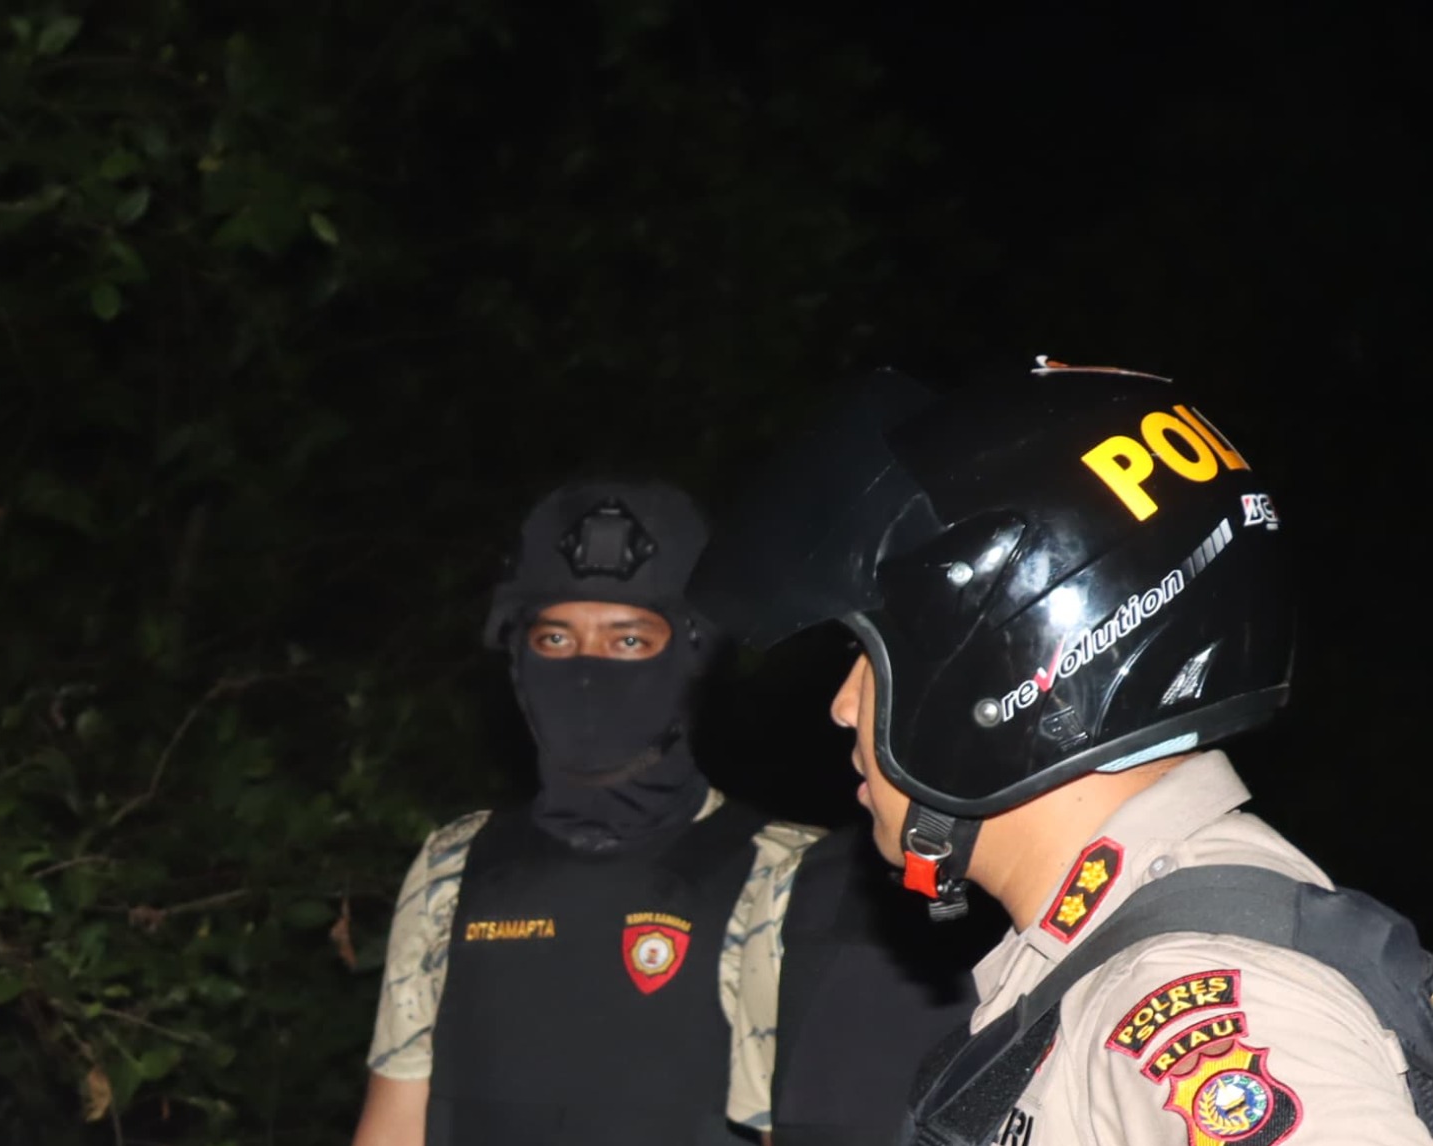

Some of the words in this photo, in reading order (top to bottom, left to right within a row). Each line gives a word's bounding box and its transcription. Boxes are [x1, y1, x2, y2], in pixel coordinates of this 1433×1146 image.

[1001, 569, 1186, 722] revolution
[1117, 977, 1228, 1045] POLRES
[1136, 991, 1221, 1042] SIAK
[1155, 1019, 1235, 1071] RIAU
